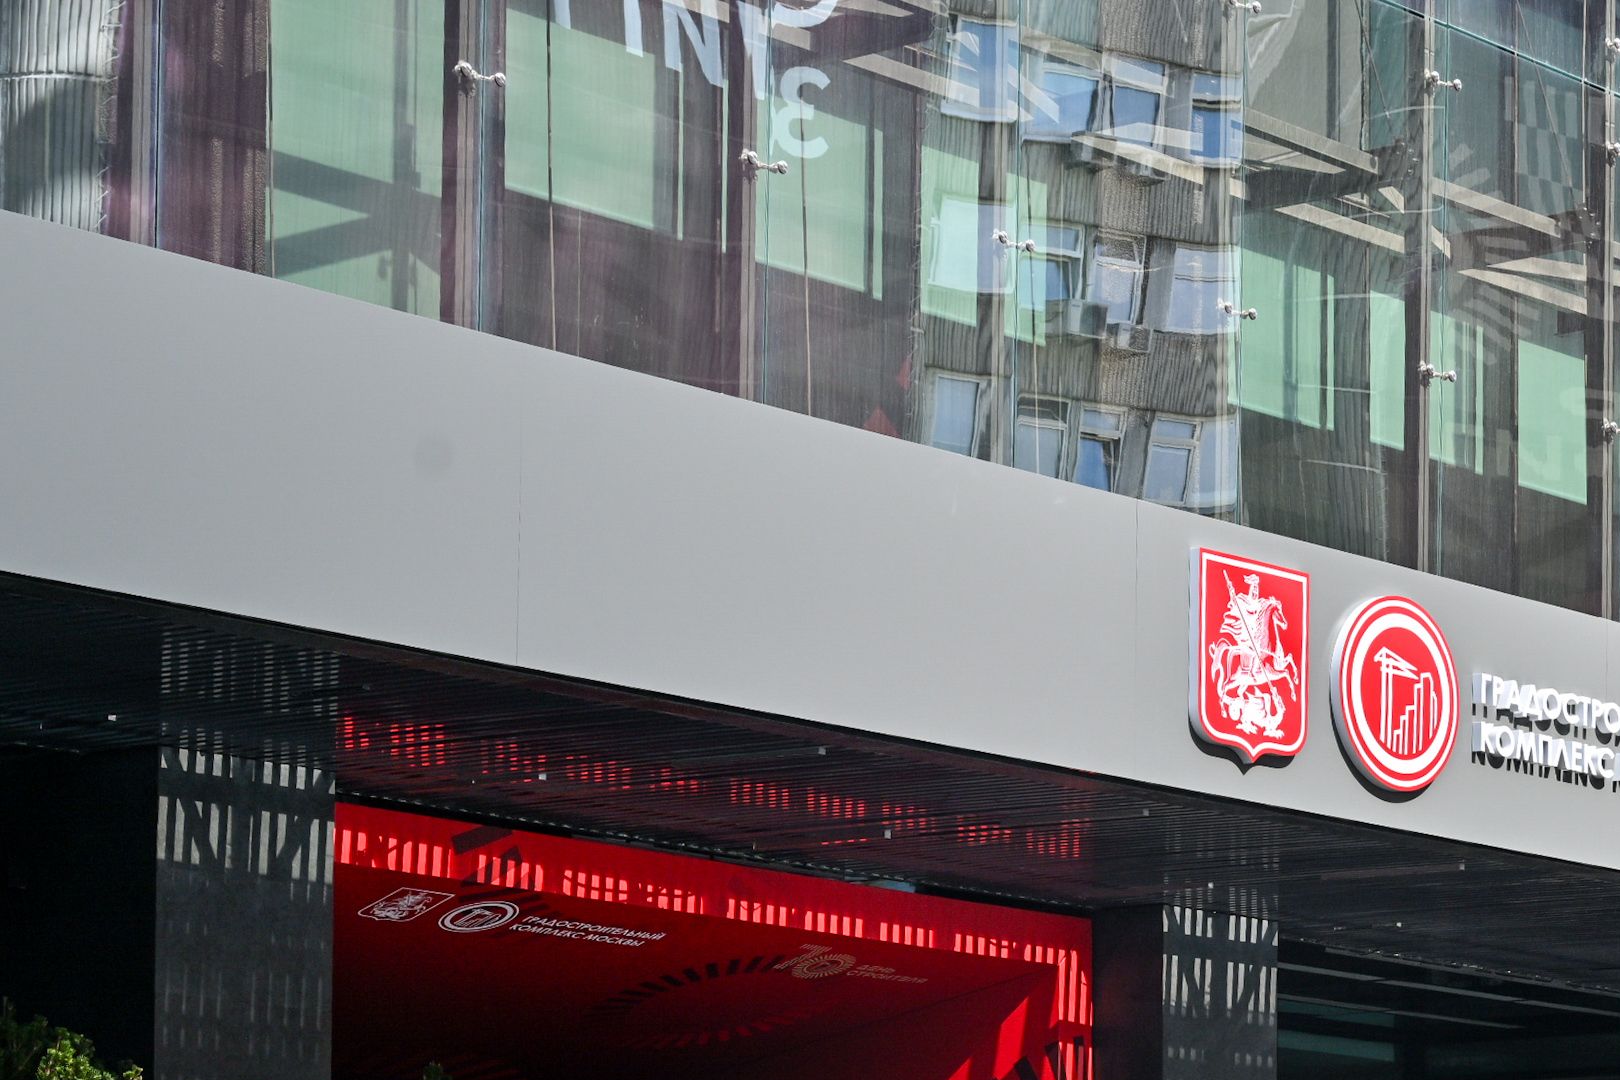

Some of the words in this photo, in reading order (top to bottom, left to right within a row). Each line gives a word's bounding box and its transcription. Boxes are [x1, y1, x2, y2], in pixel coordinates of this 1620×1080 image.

[1473, 721, 1615, 779] КОМПЛЕКС
[508, 923, 586, 940] КОМПЛЕКС
[584, 931, 646, 947] МОСКВЫ
[521, 915, 667, 941] ГРАДОСТРОИТЕЛЬНЫЙ
